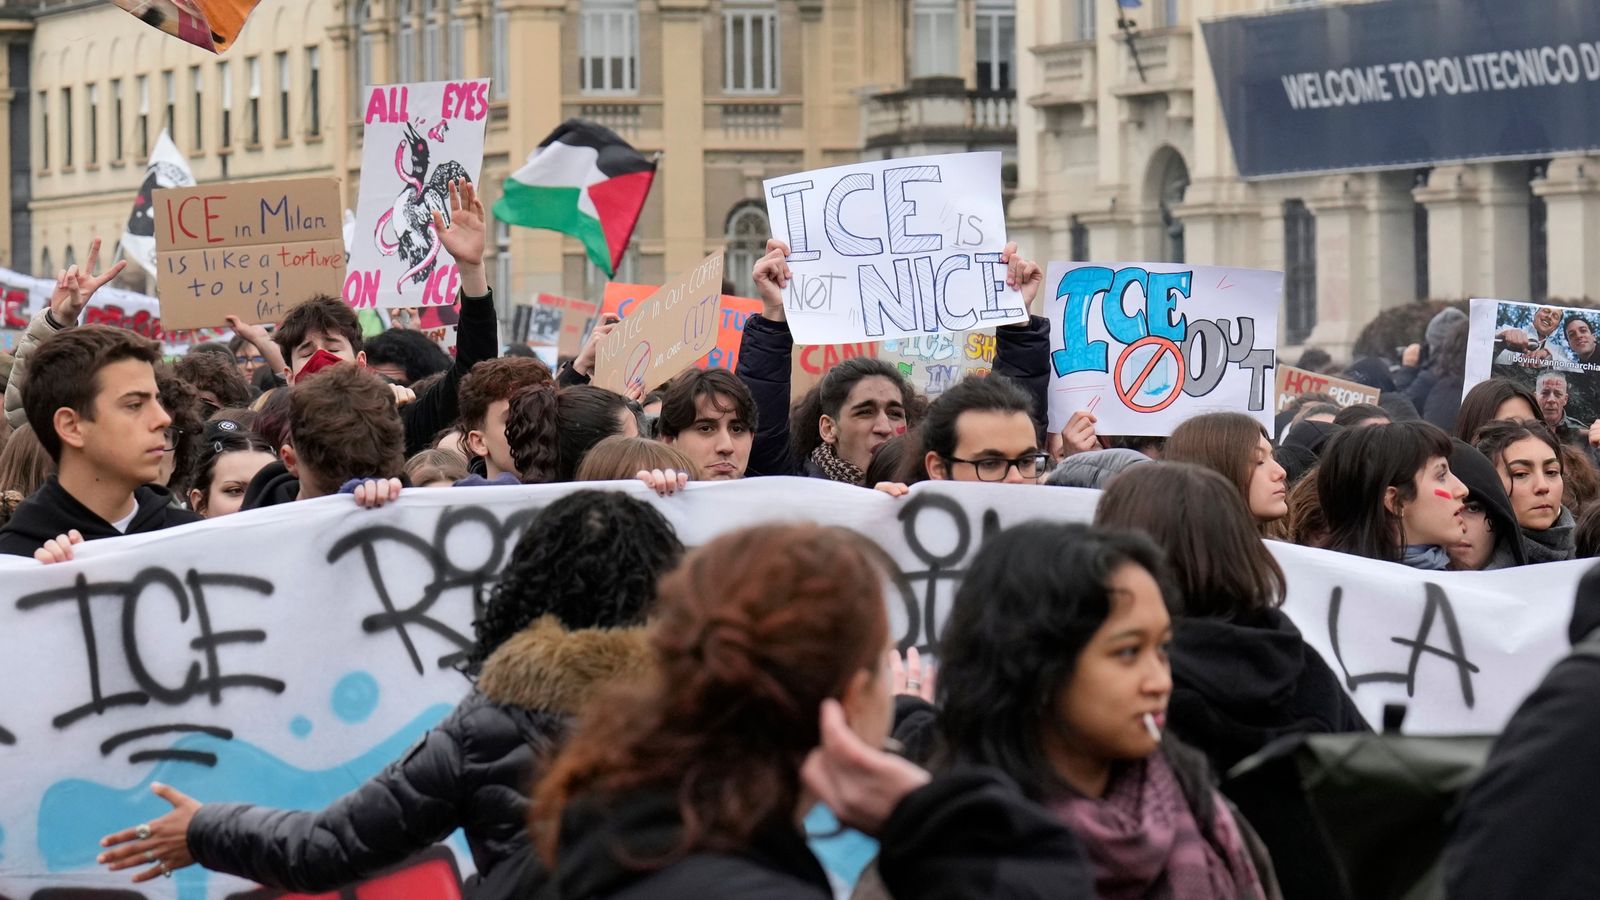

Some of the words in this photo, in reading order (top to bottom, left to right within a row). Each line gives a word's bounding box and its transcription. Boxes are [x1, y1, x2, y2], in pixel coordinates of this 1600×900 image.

[1281, 64, 1392, 110] WELCOME
[1389, 61, 1425, 99] TO
[1422, 44, 1579, 96] POLITECNICO
[365, 86, 409, 125] ALL
[441, 81, 489, 121] EYES
[167, 195, 228, 245] ICE
[234, 225, 252, 238] in
[260, 194, 327, 235] Milan
[770, 165, 942, 262] ICE
[954, 213, 984, 247] IS
[188, 278, 224, 297] to
[239, 271, 281, 297] us!
[203, 250, 250, 272] like
[259, 256, 271, 267] a
[277, 245, 343, 269] torture
[341, 269, 382, 308] ON
[421, 263, 462, 306] ICE
[857, 252, 1024, 337] NICE
[1051, 266, 1193, 378] ICE
[1181, 316, 1275, 412] OUT
[1283, 370, 1329, 394] HOT
[16, 565, 287, 728] ICE
[1327, 580, 1481, 711] LA
